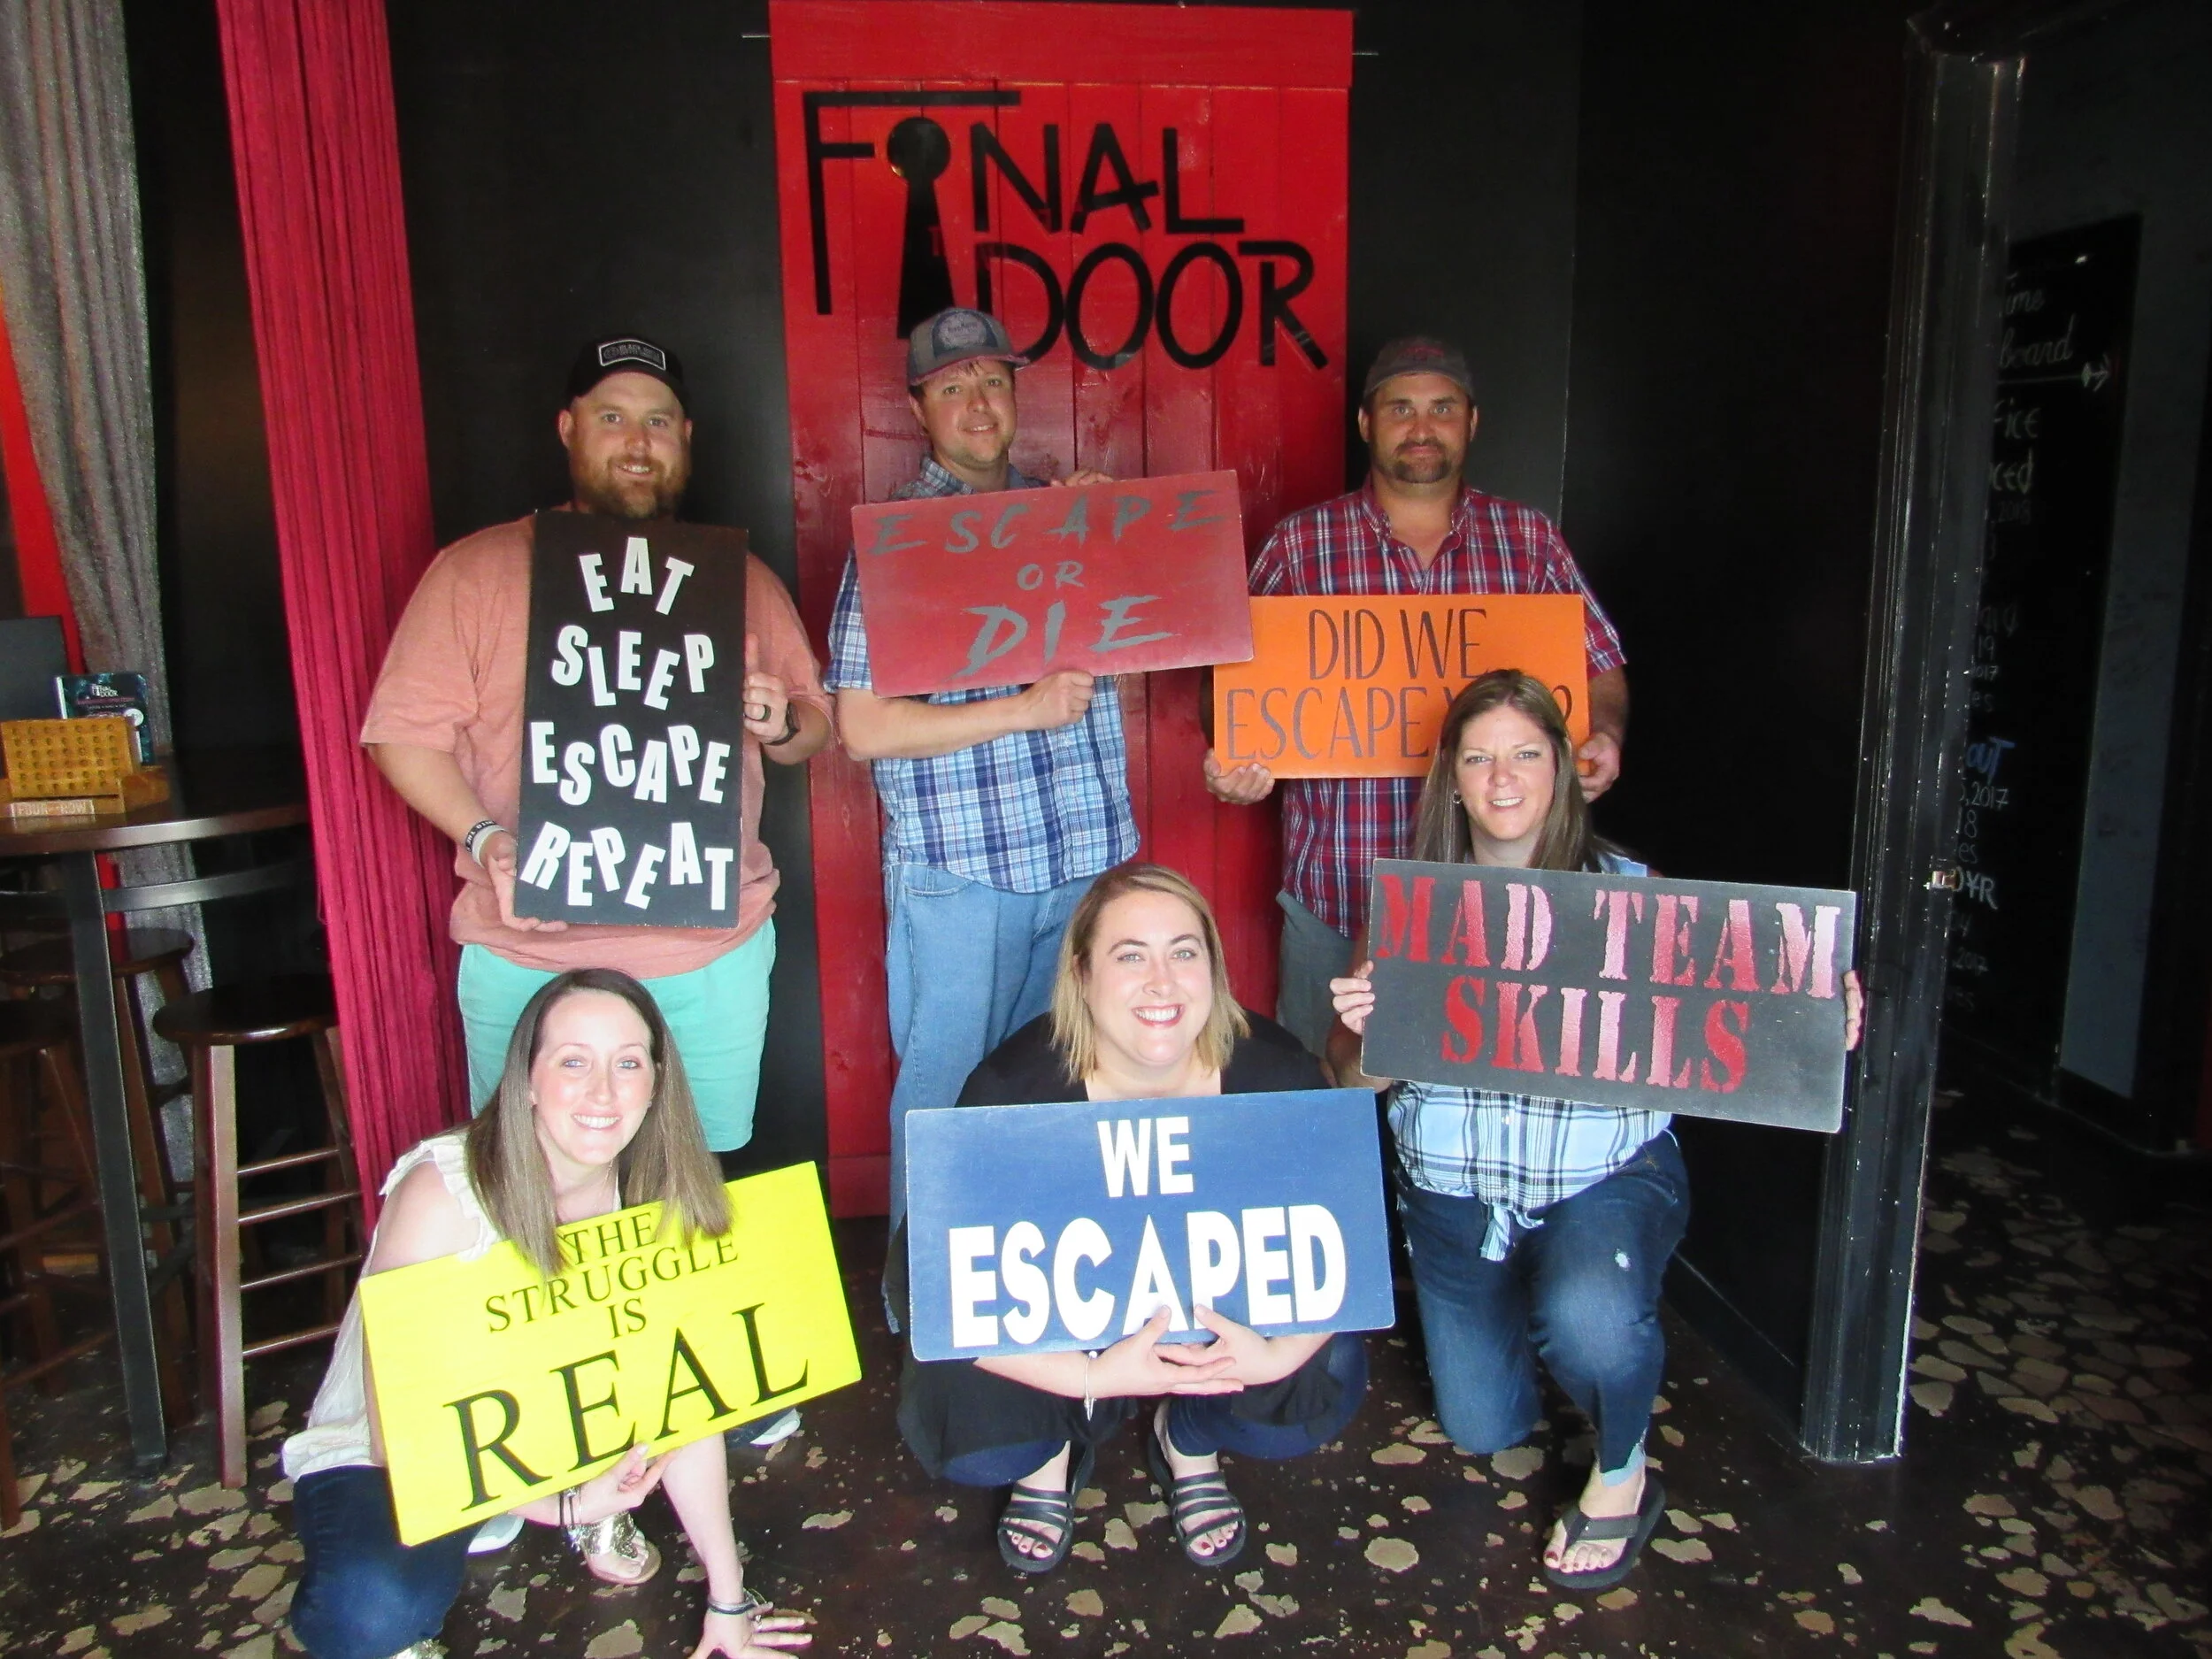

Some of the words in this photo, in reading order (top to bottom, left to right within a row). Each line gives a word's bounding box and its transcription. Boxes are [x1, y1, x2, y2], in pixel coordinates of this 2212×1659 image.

[803, 91, 1243, 340] FINAL
[976, 241, 1328, 369] DOOR
[867, 490, 1227, 557] ESCAPE
[580, 537, 694, 615] EAT
[1017, 560, 1085, 591] OR
[551, 626, 715, 710] SLEEP
[945, 595, 1182, 683] DIE
[1309, 609, 1385, 680] DID
[1400, 609, 1490, 680] WE
[531, 721, 730, 805] ESCAPE
[1227, 686, 1430, 761] ESCAPE
[519, 821, 733, 910] REPEAT
[1375, 874, 1552, 971] MAD
[1594, 891, 1840, 1000] TEAM
[1440, 975, 1749, 1094] SKILLS
[1097, 1116, 1194, 1198] WE
[563, 1212, 657, 1265] THE
[949, 1204, 1347, 1348] ESCAPED
[485, 1237, 738, 1333] STRUGGLE
[609, 1298, 647, 1339] IS
[442, 1302, 809, 1512] REAL
